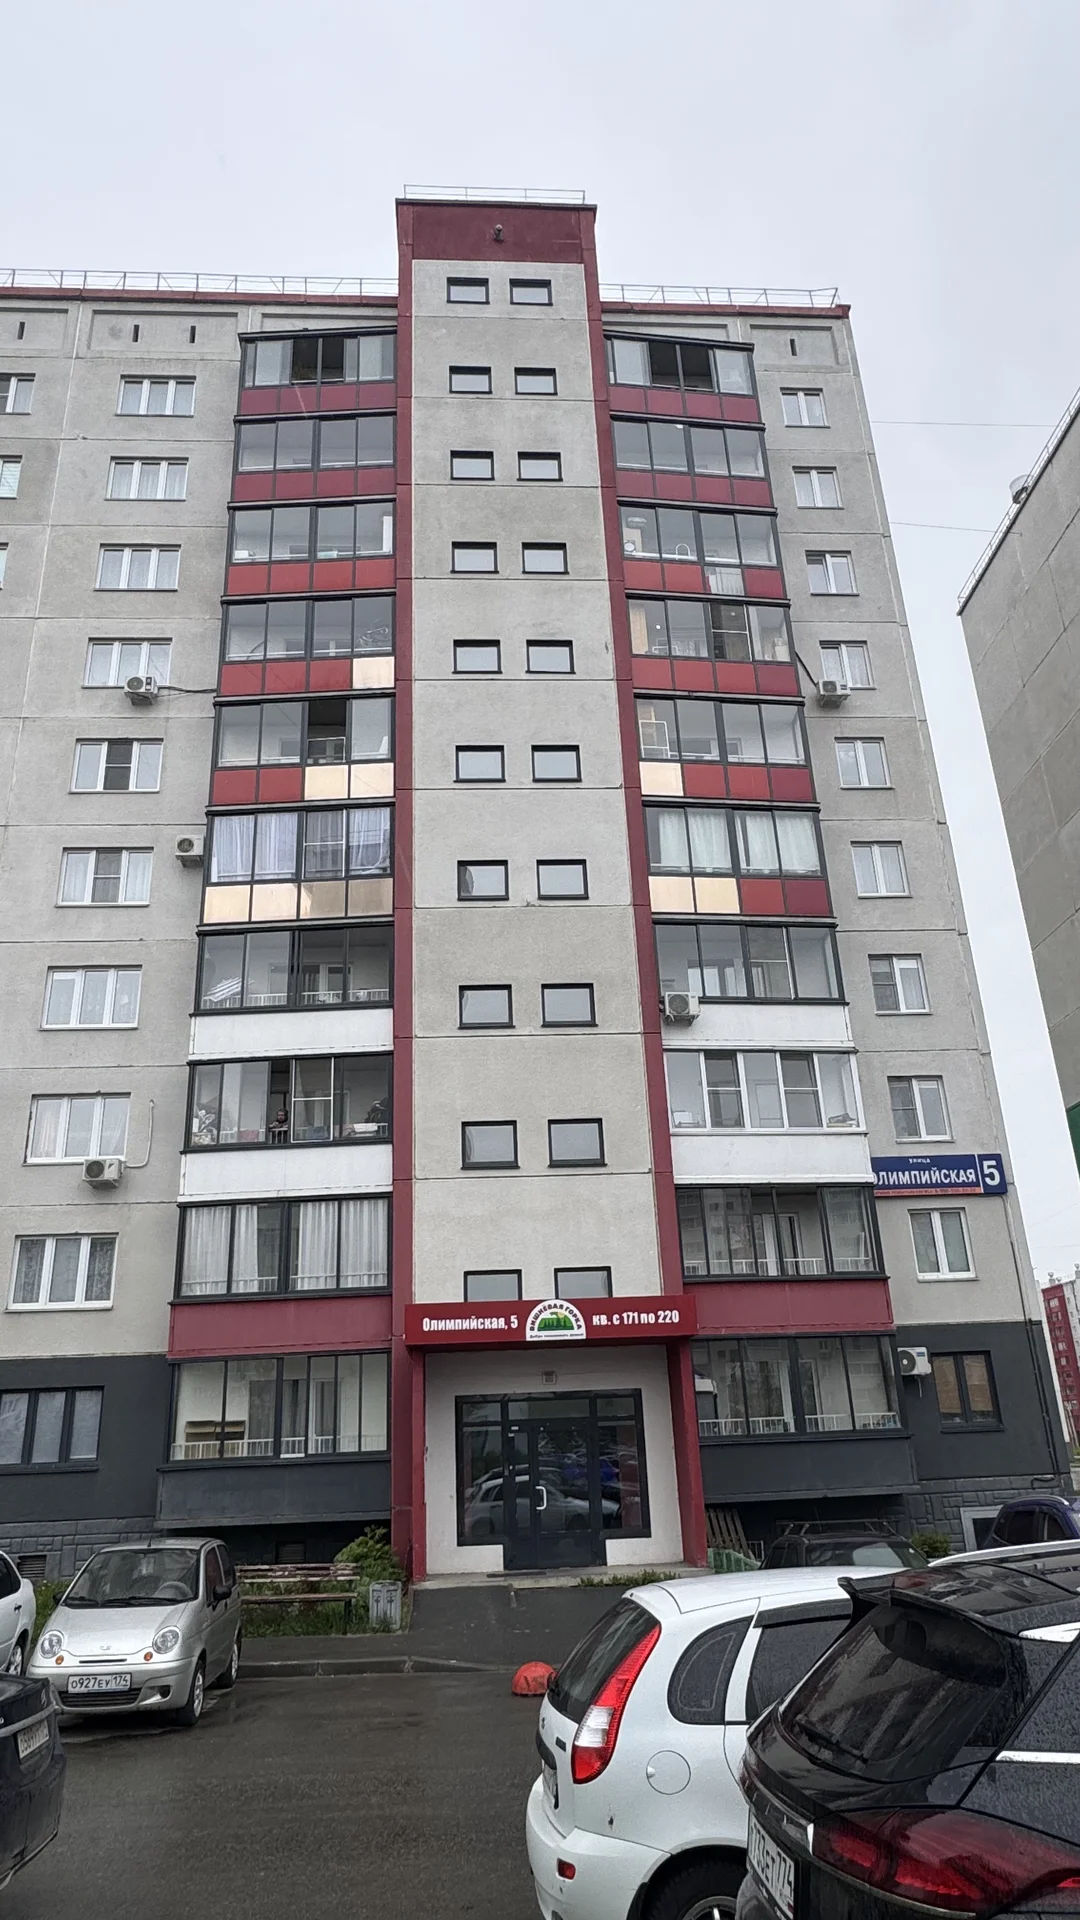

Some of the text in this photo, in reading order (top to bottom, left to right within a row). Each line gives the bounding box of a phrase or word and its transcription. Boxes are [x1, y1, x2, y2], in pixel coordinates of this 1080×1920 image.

[983, 1160, 1000, 1186] 5
[422, 1315, 518, 1331] Олимпийская, 5
[565, 1306, 583, 1330] ГОРКА
[592, 1310, 680, 1326] кв. с 171 по 220
